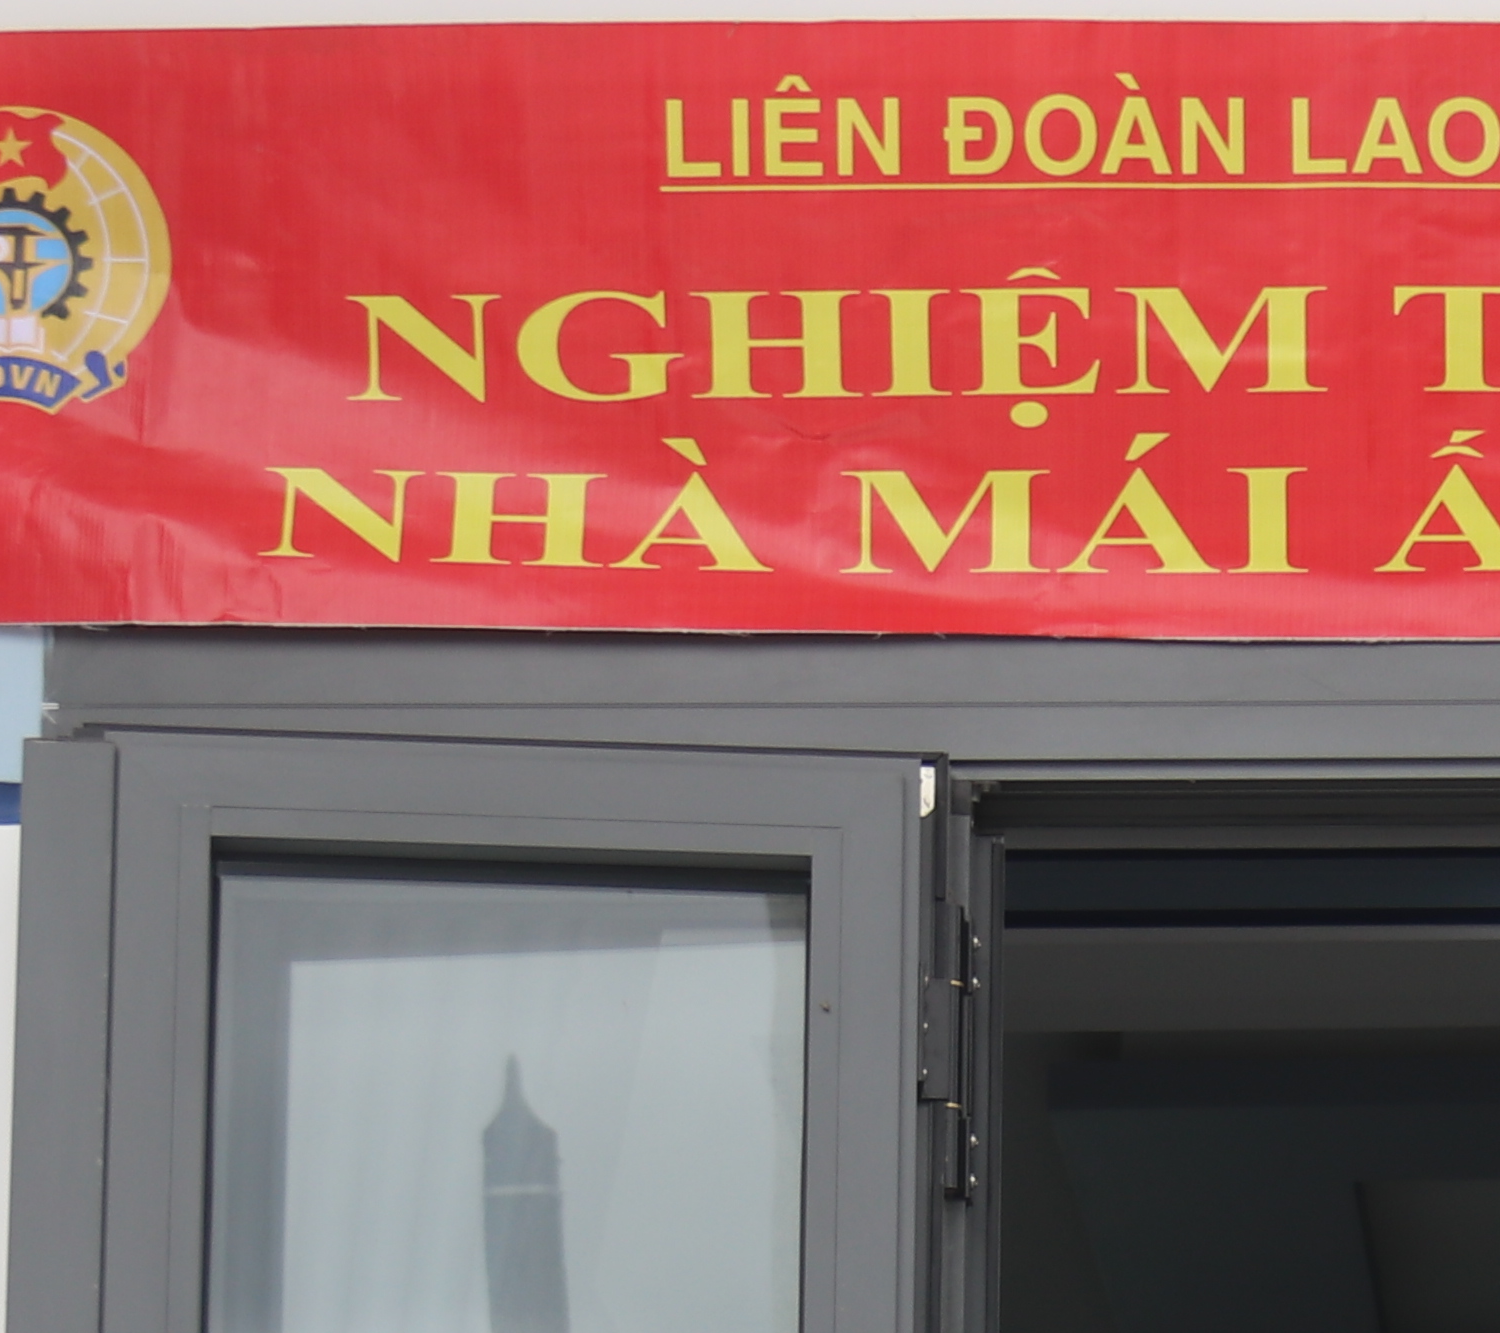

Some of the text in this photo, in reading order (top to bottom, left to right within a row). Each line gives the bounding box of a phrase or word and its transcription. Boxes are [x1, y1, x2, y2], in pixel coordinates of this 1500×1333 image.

[663, 72, 902, 180] LIÊN
[941, 70, 1247, 178] ĐOÀN
[345, 265, 1329, 430] NGHIỆM
[258, 436, 775, 574] NHÀ
[840, 430, 1309, 575] MÁI
